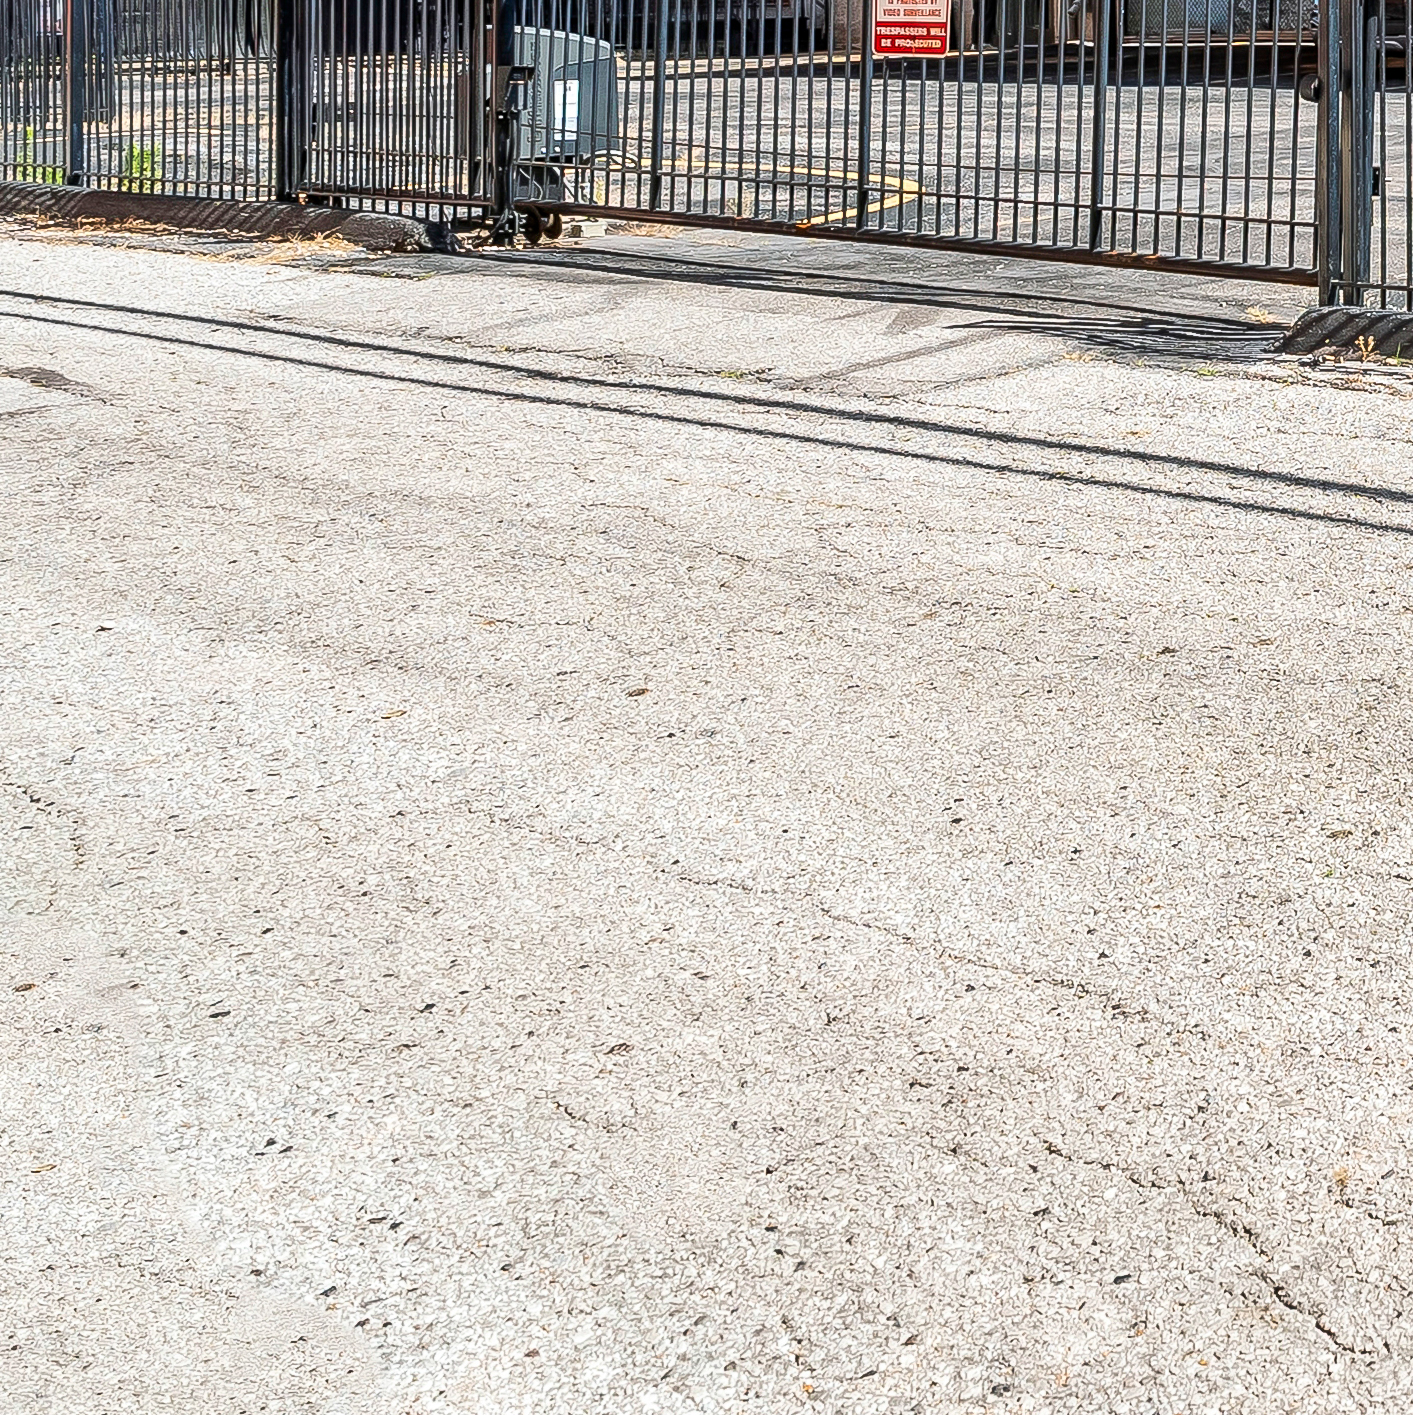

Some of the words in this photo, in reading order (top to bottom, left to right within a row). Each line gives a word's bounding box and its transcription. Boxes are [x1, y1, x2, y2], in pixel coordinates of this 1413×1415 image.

[876, 27, 927, 35] TRESPASSERS
[930, 27, 946, 36] WILL
[895, 39, 942, 47] PROSECUTED
